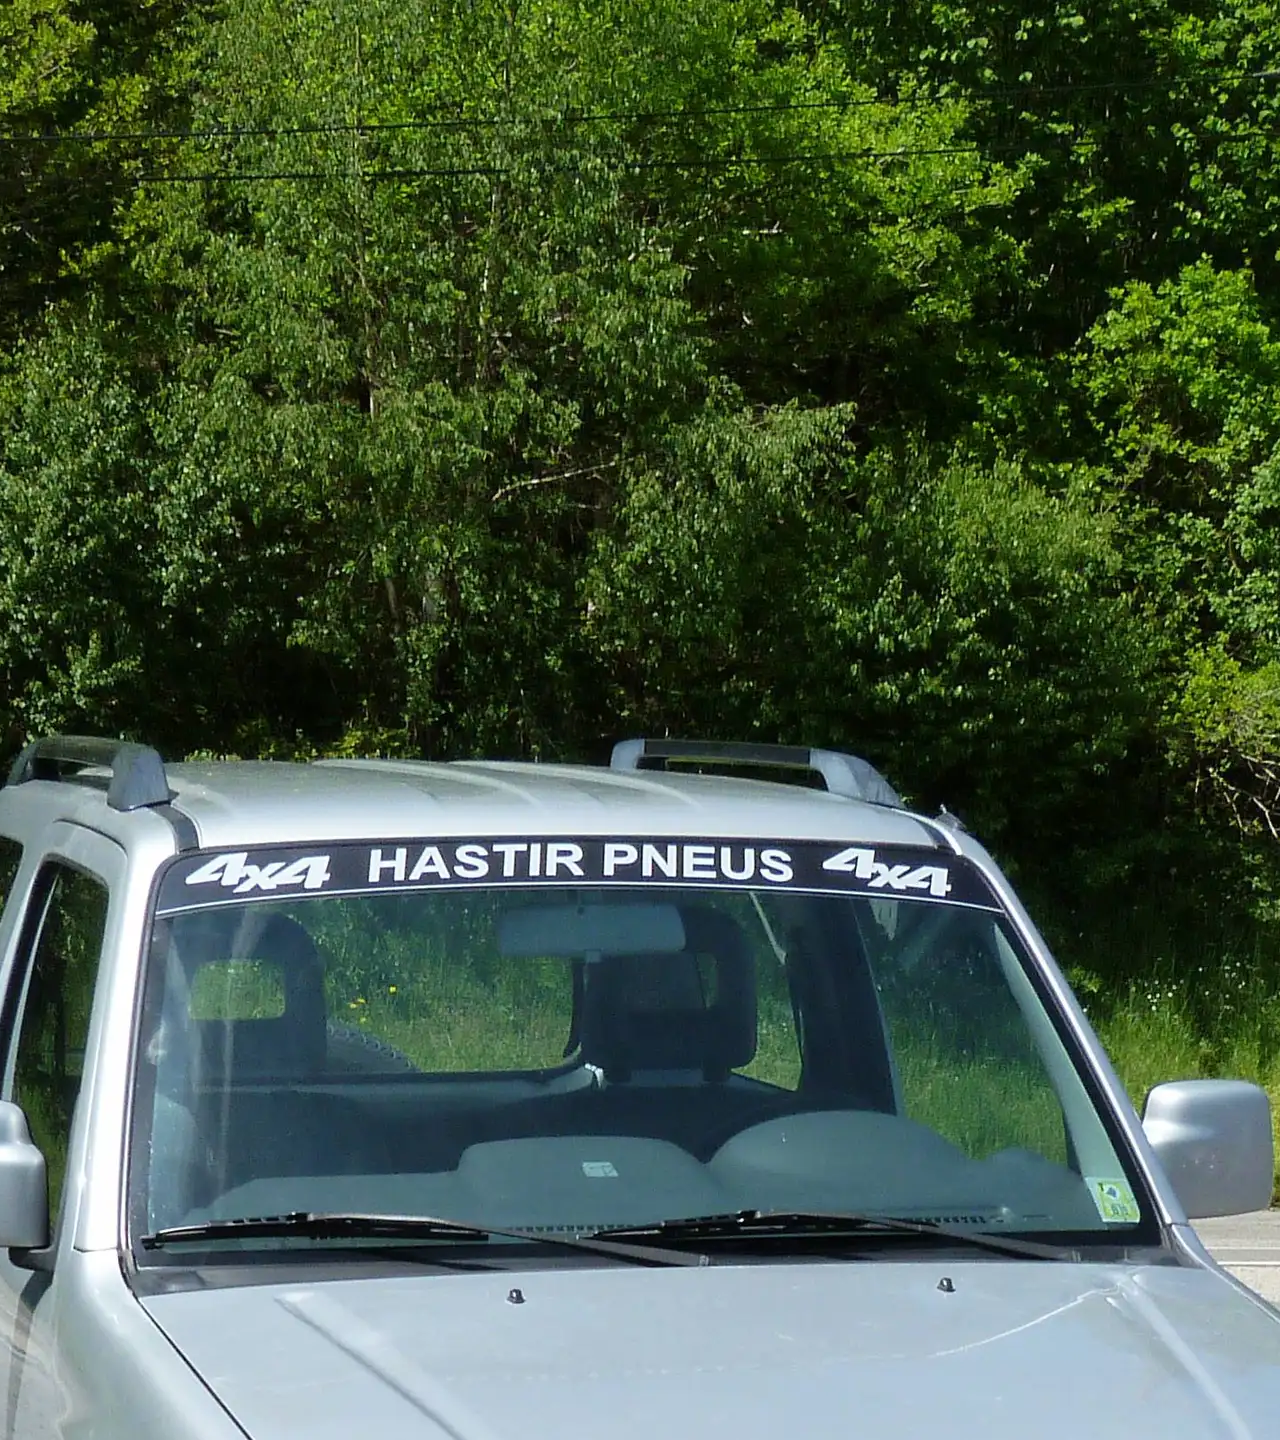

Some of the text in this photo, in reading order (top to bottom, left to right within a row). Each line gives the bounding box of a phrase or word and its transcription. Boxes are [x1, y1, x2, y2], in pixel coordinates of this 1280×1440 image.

[184, 842, 952, 897] 4x4 HASTIR PNEUS 4x4
